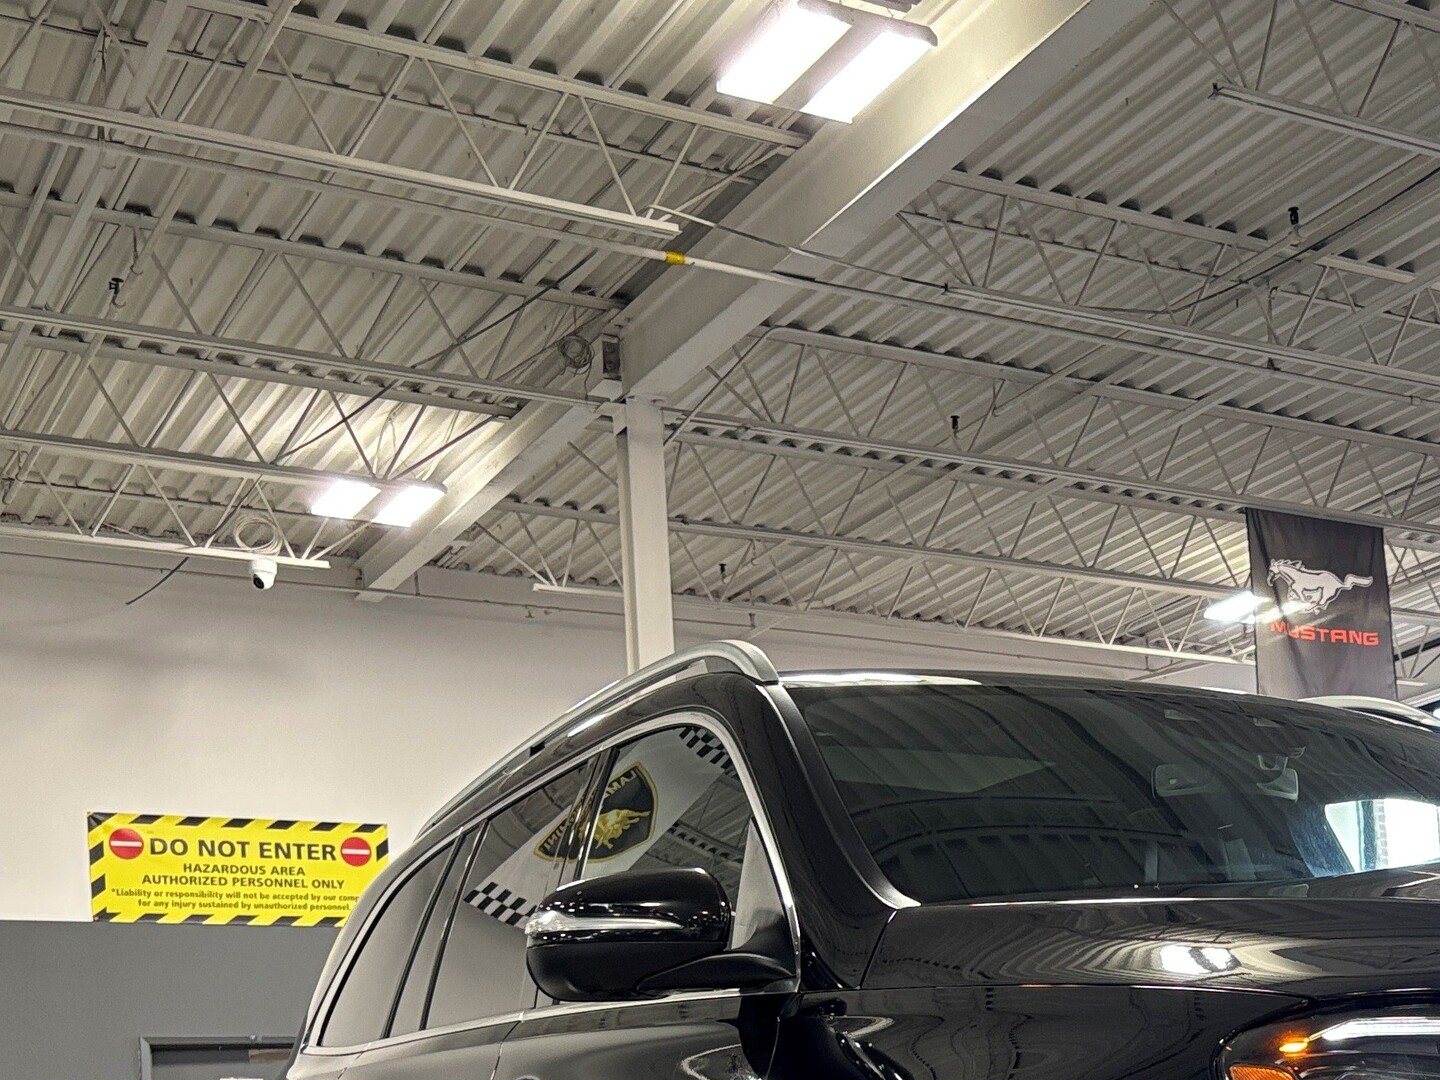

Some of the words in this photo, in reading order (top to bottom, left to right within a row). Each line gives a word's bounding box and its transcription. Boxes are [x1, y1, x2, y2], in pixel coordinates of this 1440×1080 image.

[1269, 620, 1380, 646] MUSTANG
[150, 837, 189, 857] DO
[198, 839, 250, 858] NOT
[259, 841, 337, 861] ENTER
[183, 863, 266, 875] HAZARDOUS
[270, 866, 306, 876] AREA
[142, 874, 228, 887] AUTHORIZED
[232, 877, 309, 889] PERSONNEL
[311, 879, 345, 890] ONLY
[154, 890, 164, 898] or
[166, 889, 223, 901] responsibility
[225, 891, 241, 899] will
[243, 892, 258, 900] not
[260, 892, 270, 900] be
[272, 893, 309, 902] accepted
[311, 893, 321, 902] by
[138, 898, 152, 907] for
[154, 900, 169, 909] any
[171, 899, 197, 910] injury
[198, 900, 239, 908] sustained
[241, 901, 252, 911] by
[253, 902, 308, 910] unauthorized
